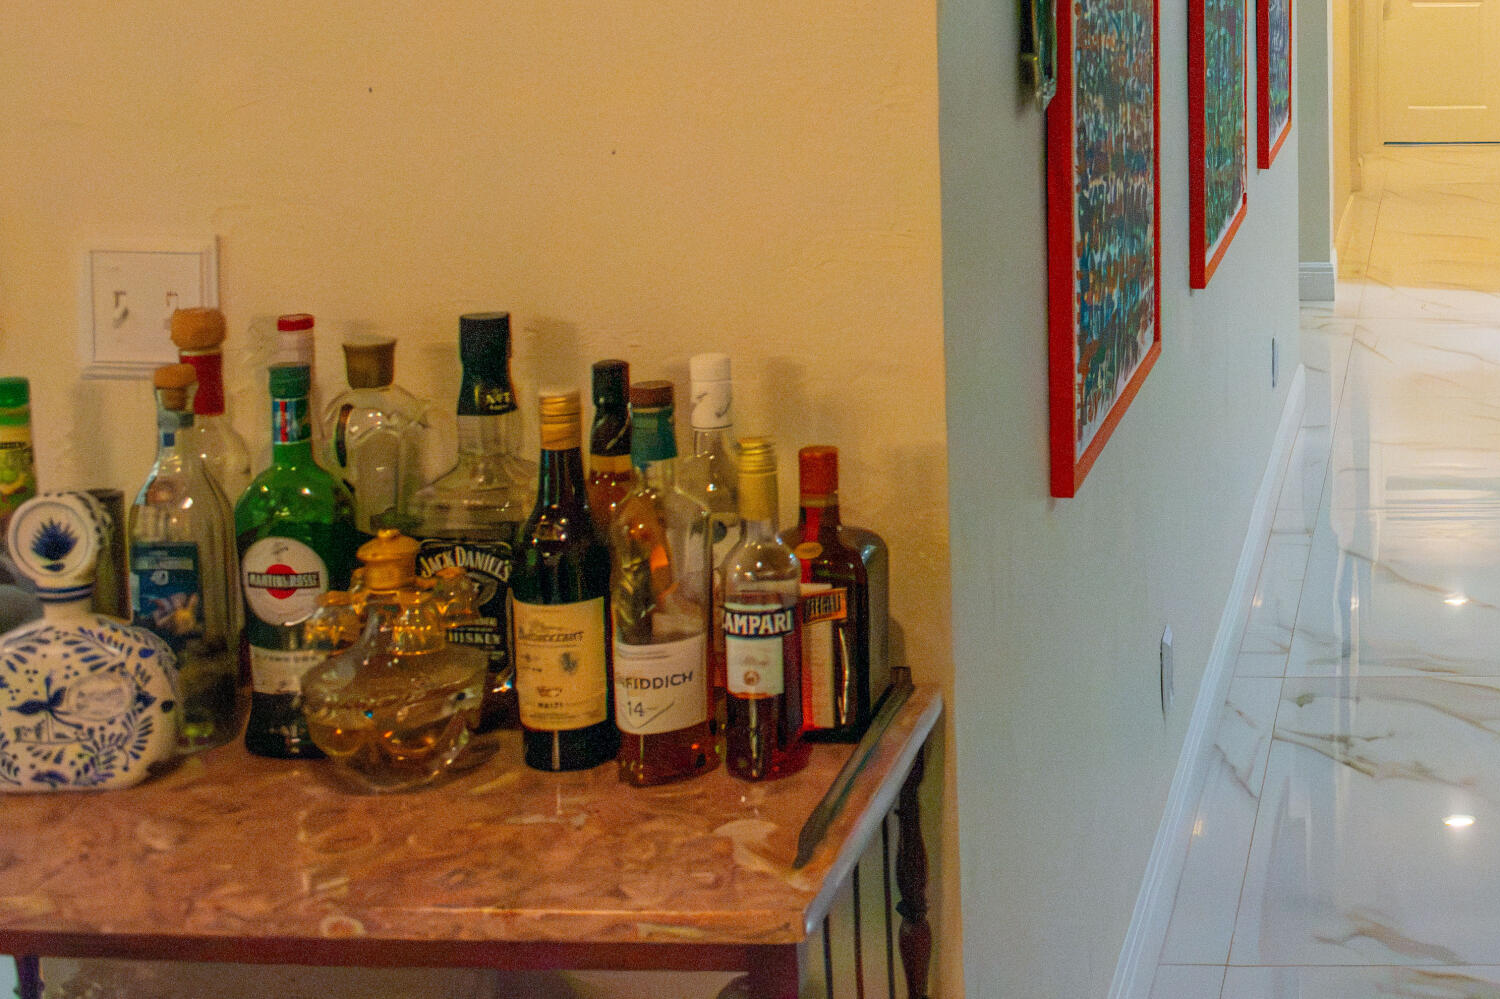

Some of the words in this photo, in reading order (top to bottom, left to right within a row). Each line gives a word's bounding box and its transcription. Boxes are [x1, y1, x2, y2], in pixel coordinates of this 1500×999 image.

[448, 631, 500, 644] HISKEY
[619, 671, 693, 690] FIDDICH
[627, 701, 645, 717] 14
